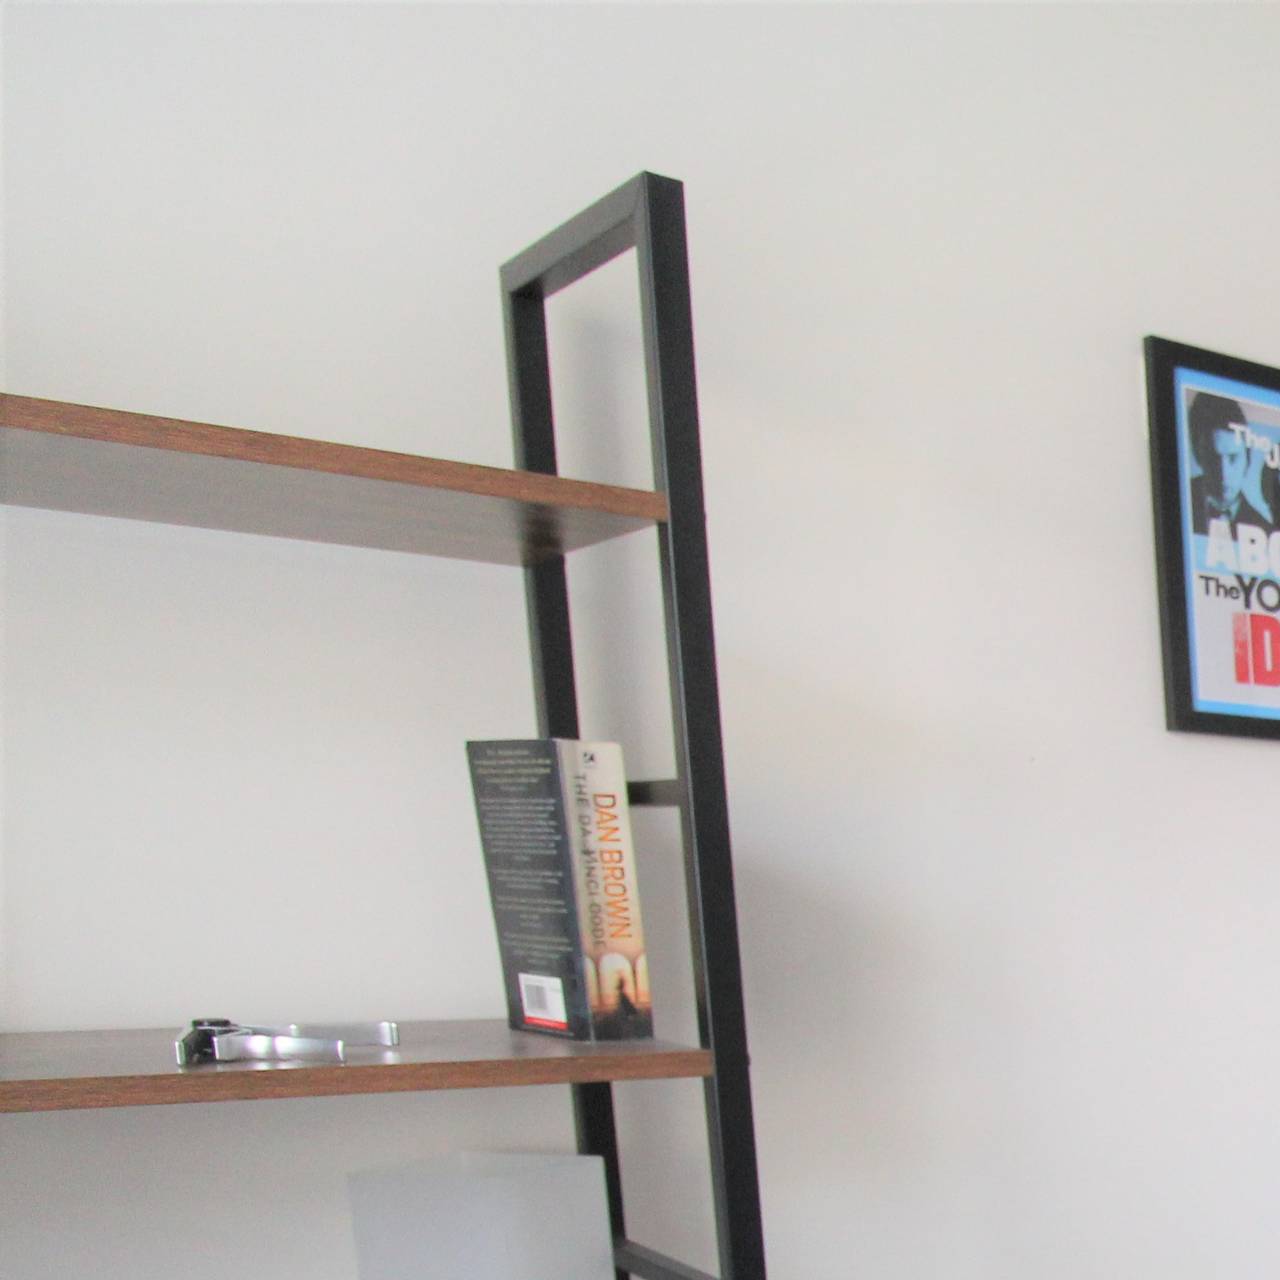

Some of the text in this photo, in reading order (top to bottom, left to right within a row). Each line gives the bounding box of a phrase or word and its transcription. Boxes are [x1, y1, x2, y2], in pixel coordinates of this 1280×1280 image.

[1228, 421, 1271, 450] The
[1198, 575, 1241, 600] The
[574, 774, 589, 805] THE
[578, 815, 592, 838] DA
[592, 792, 633, 940] DAN BROWN
[589, 904, 606, 948] CODE
